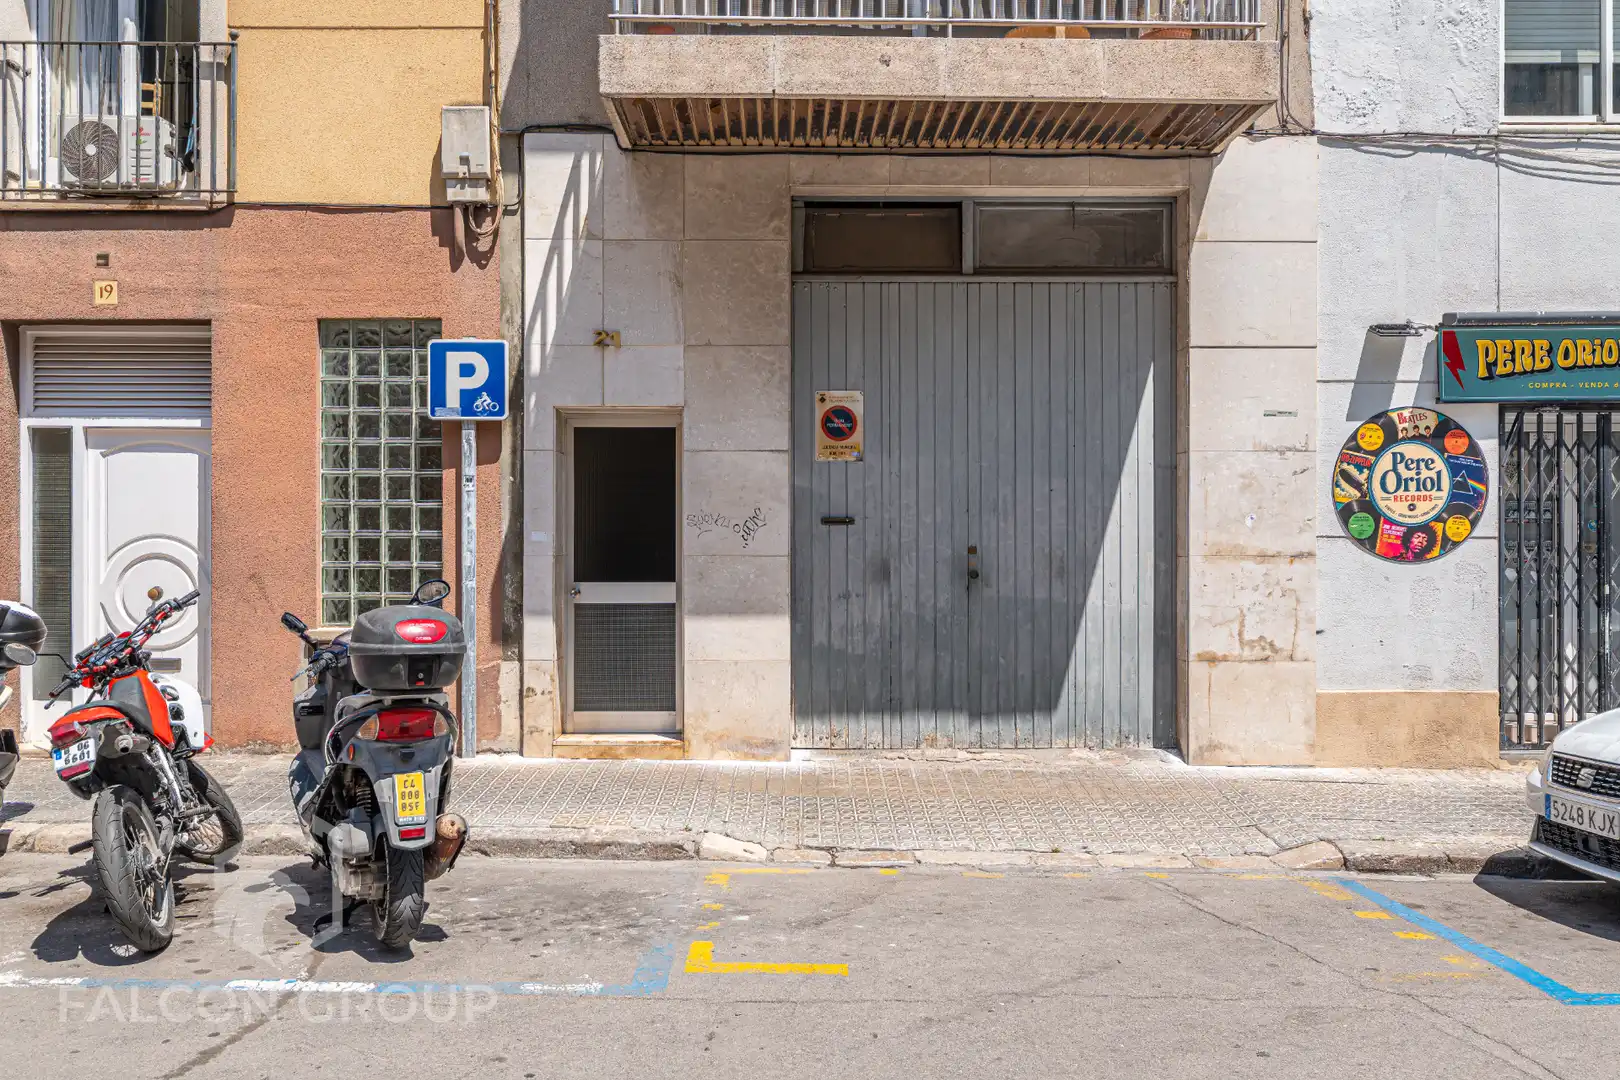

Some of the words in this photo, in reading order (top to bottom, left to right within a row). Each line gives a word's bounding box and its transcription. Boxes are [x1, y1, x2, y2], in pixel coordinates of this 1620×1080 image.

[99, 284, 114, 300] 19
[592, 329, 621, 348] 21
[1475, 338, 1553, 380] PERE
[445, 351, 490, 409] P
[1391, 452, 1436, 471] Pere
[1380, 469, 1444, 494] Oriol
[1393, 494, 1433, 503] RECORDS
[403, 779, 415, 788] C4
[1552, 800, 1584, 826] 5248
[1589, 810, 1615, 835] KJX
